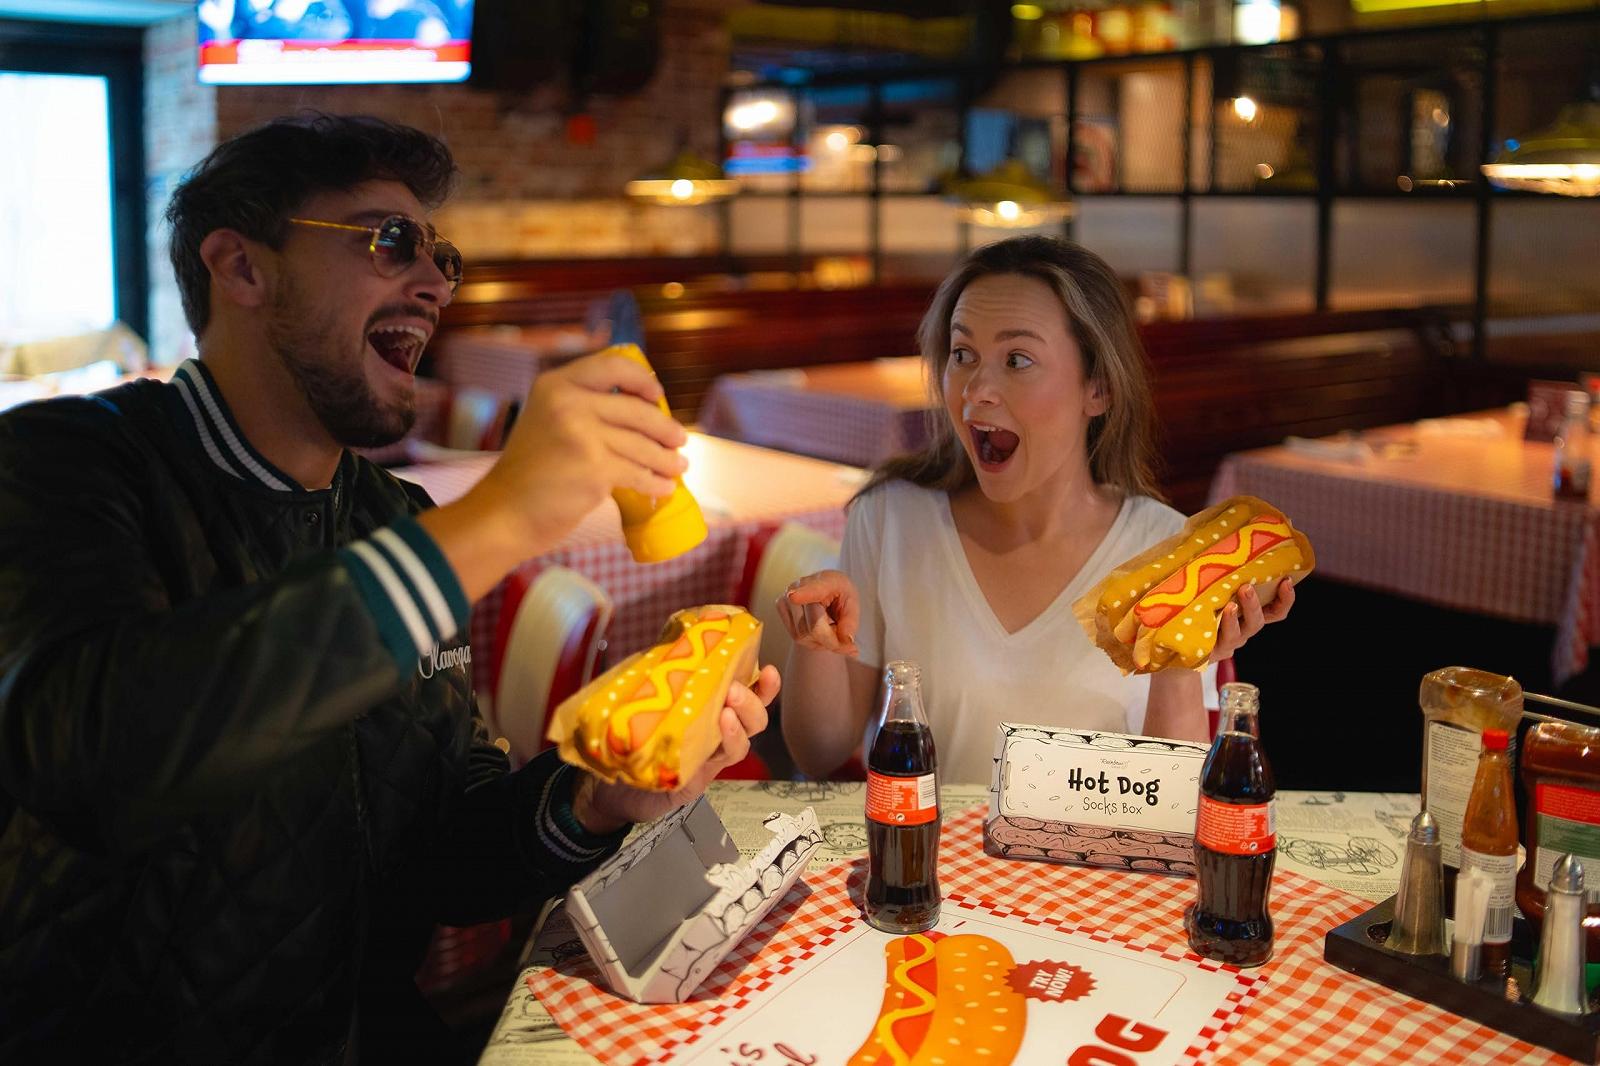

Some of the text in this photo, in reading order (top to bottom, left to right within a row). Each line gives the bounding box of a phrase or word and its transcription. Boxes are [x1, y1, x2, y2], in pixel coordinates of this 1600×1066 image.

[1068, 767, 1161, 807] Hot Dog
[1083, 796, 1143, 816] Socks Box
[1029, 969, 1054, 990] TRY
[1045, 967, 1075, 998] NOW!
